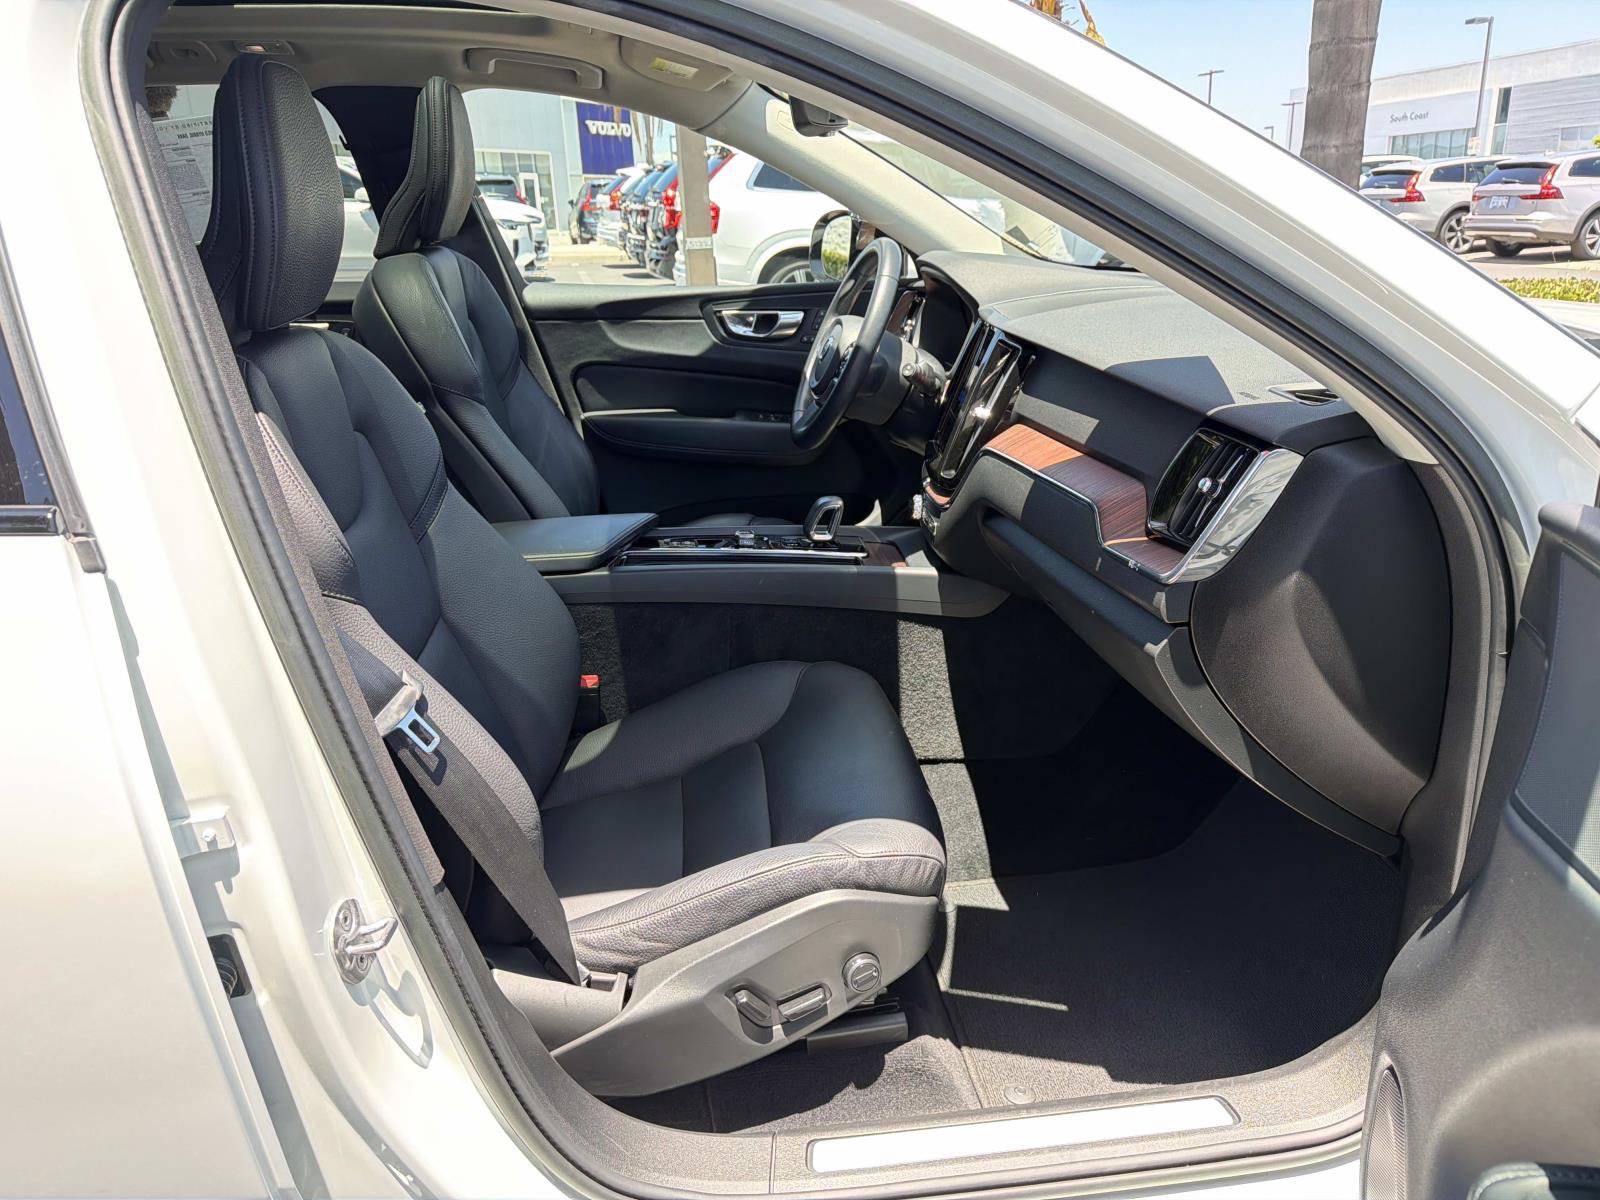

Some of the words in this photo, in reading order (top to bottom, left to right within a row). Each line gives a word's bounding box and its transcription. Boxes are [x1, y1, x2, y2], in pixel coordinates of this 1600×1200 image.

[1390, 112, 1408, 123] South
[1410, 112, 1429, 120] Coast
[585, 120, 631, 137] VOLVO
